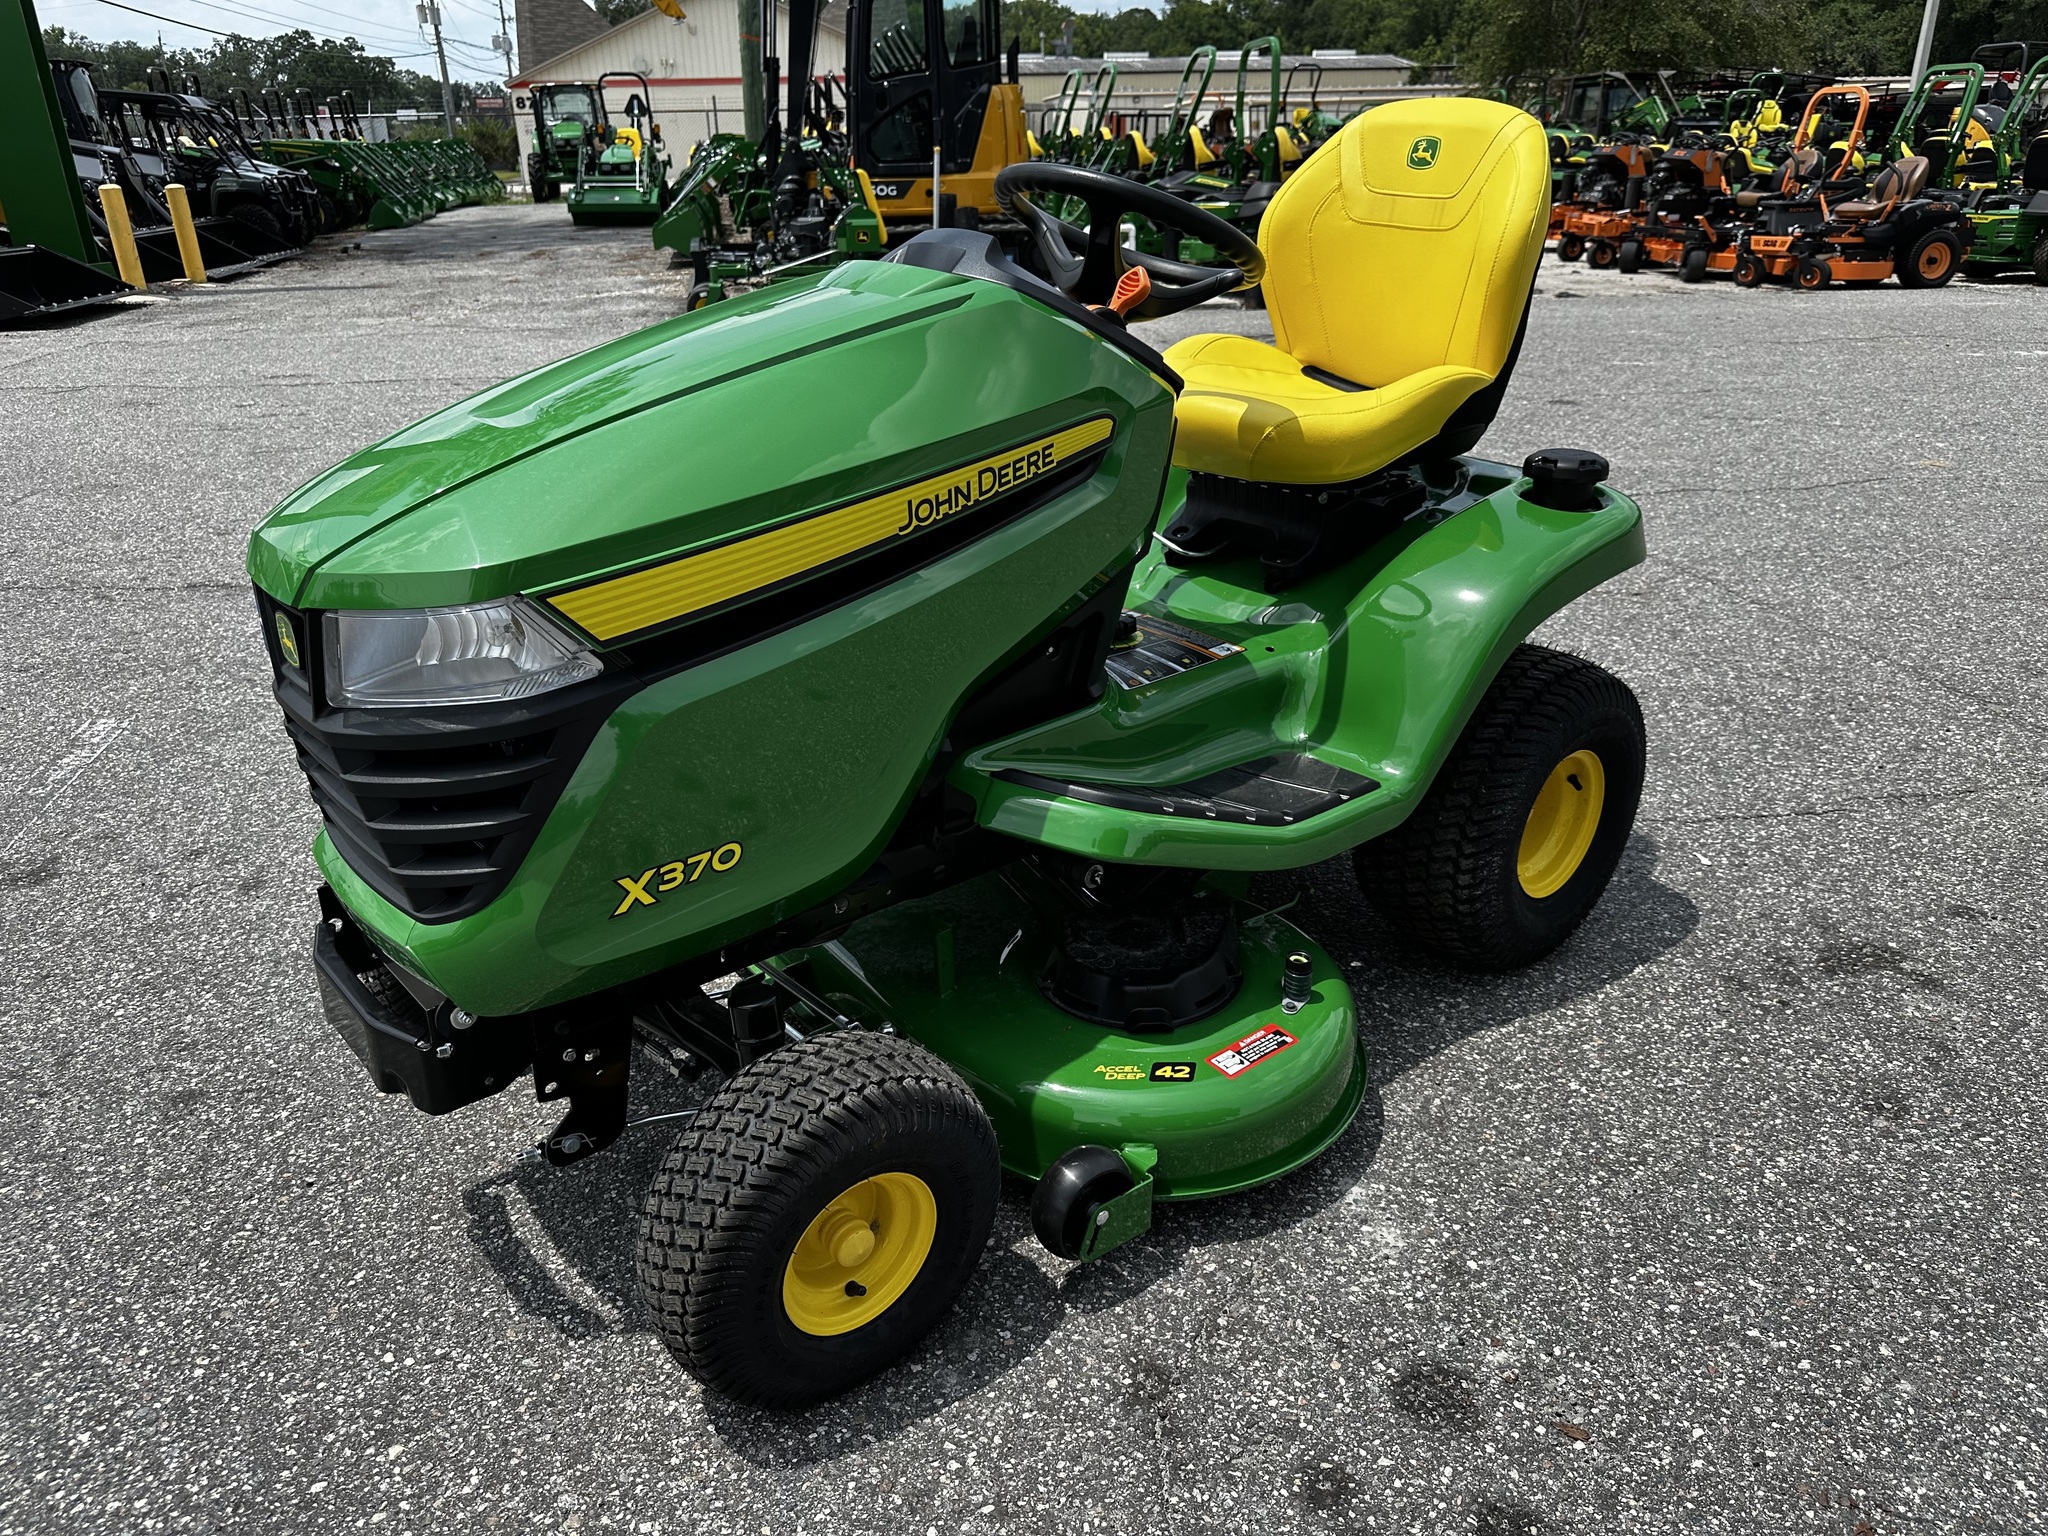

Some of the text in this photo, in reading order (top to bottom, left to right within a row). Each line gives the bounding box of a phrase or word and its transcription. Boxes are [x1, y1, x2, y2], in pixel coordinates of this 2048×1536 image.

[898, 443, 1057, 535] JOHN DEERE
[611, 842, 742, 917] X370
[1093, 1065, 1141, 1073] ACCEL
[1154, 1065, 1190, 1078] 42
